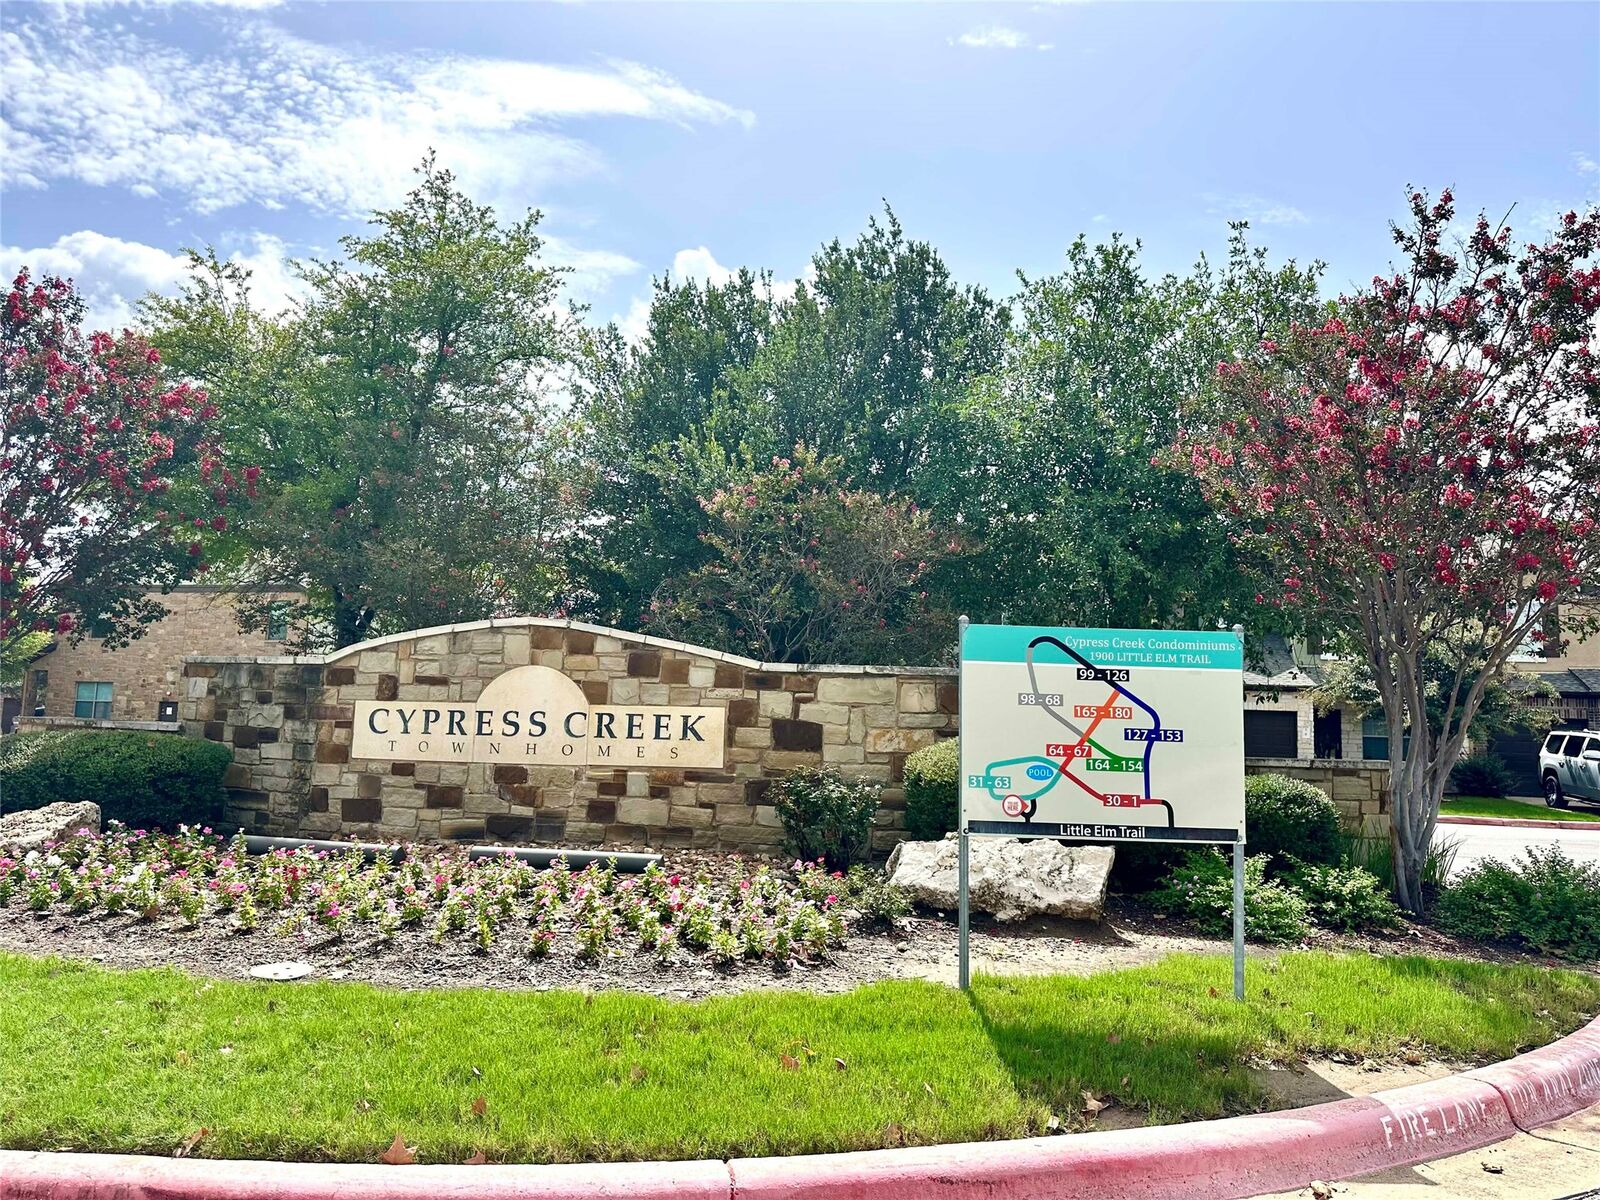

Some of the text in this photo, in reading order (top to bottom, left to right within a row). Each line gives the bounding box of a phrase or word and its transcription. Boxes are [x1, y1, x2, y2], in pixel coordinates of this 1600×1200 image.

[1065, 635, 1235, 651] Cypress Creek Condominiums
[1090, 651, 1211, 664] 1900 LITTLE ELM TRAIL
[1079, 669, 1095, 680] 99
[1105, 670, 1127, 681] 126
[1020, 694, 1034, 705] 98
[1045, 695, 1061, 706] 68
[1075, 707, 1098, 718] 165
[1108, 707, 1131, 719] 180
[368, 708, 706, 742] CYPRESS CREEK
[1126, 729, 1148, 740] 127
[1159, 731, 1181, 741] 153
[388, 740, 679, 759] TOWNHOMES
[1049, 746, 1064, 756] 64
[1074, 746, 1089, 757] 67
[1088, 760, 1110, 770] 164
[1121, 760, 1143, 771] 154
[1028, 768, 1052, 777] POOL
[969, 777, 983, 787] 31
[994, 778, 1009, 788] 63
[1105, 795, 1121, 806] 30
[1132, 796, 1138, 807] 1
[1060, 824, 1146, 838] Little Elm Trail
[1380, 1094, 1486, 1149] FIRE LANE
